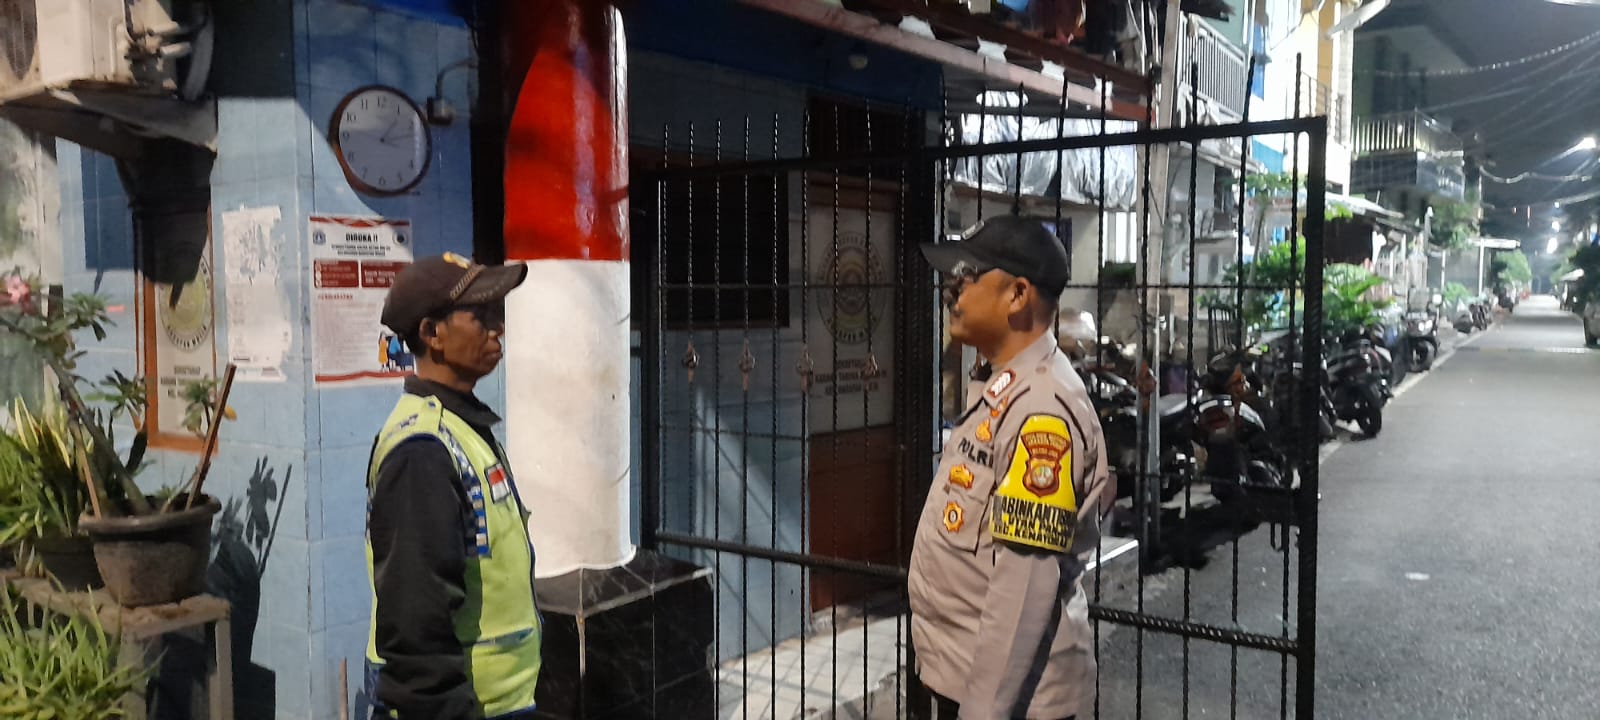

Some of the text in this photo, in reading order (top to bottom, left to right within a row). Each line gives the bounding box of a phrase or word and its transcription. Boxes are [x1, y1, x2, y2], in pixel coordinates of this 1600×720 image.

[361, 99, 368, 110] 11
[377, 95, 387, 109] 12
[346, 111, 357, 123] 10
[957, 436, 994, 469] POLRI
